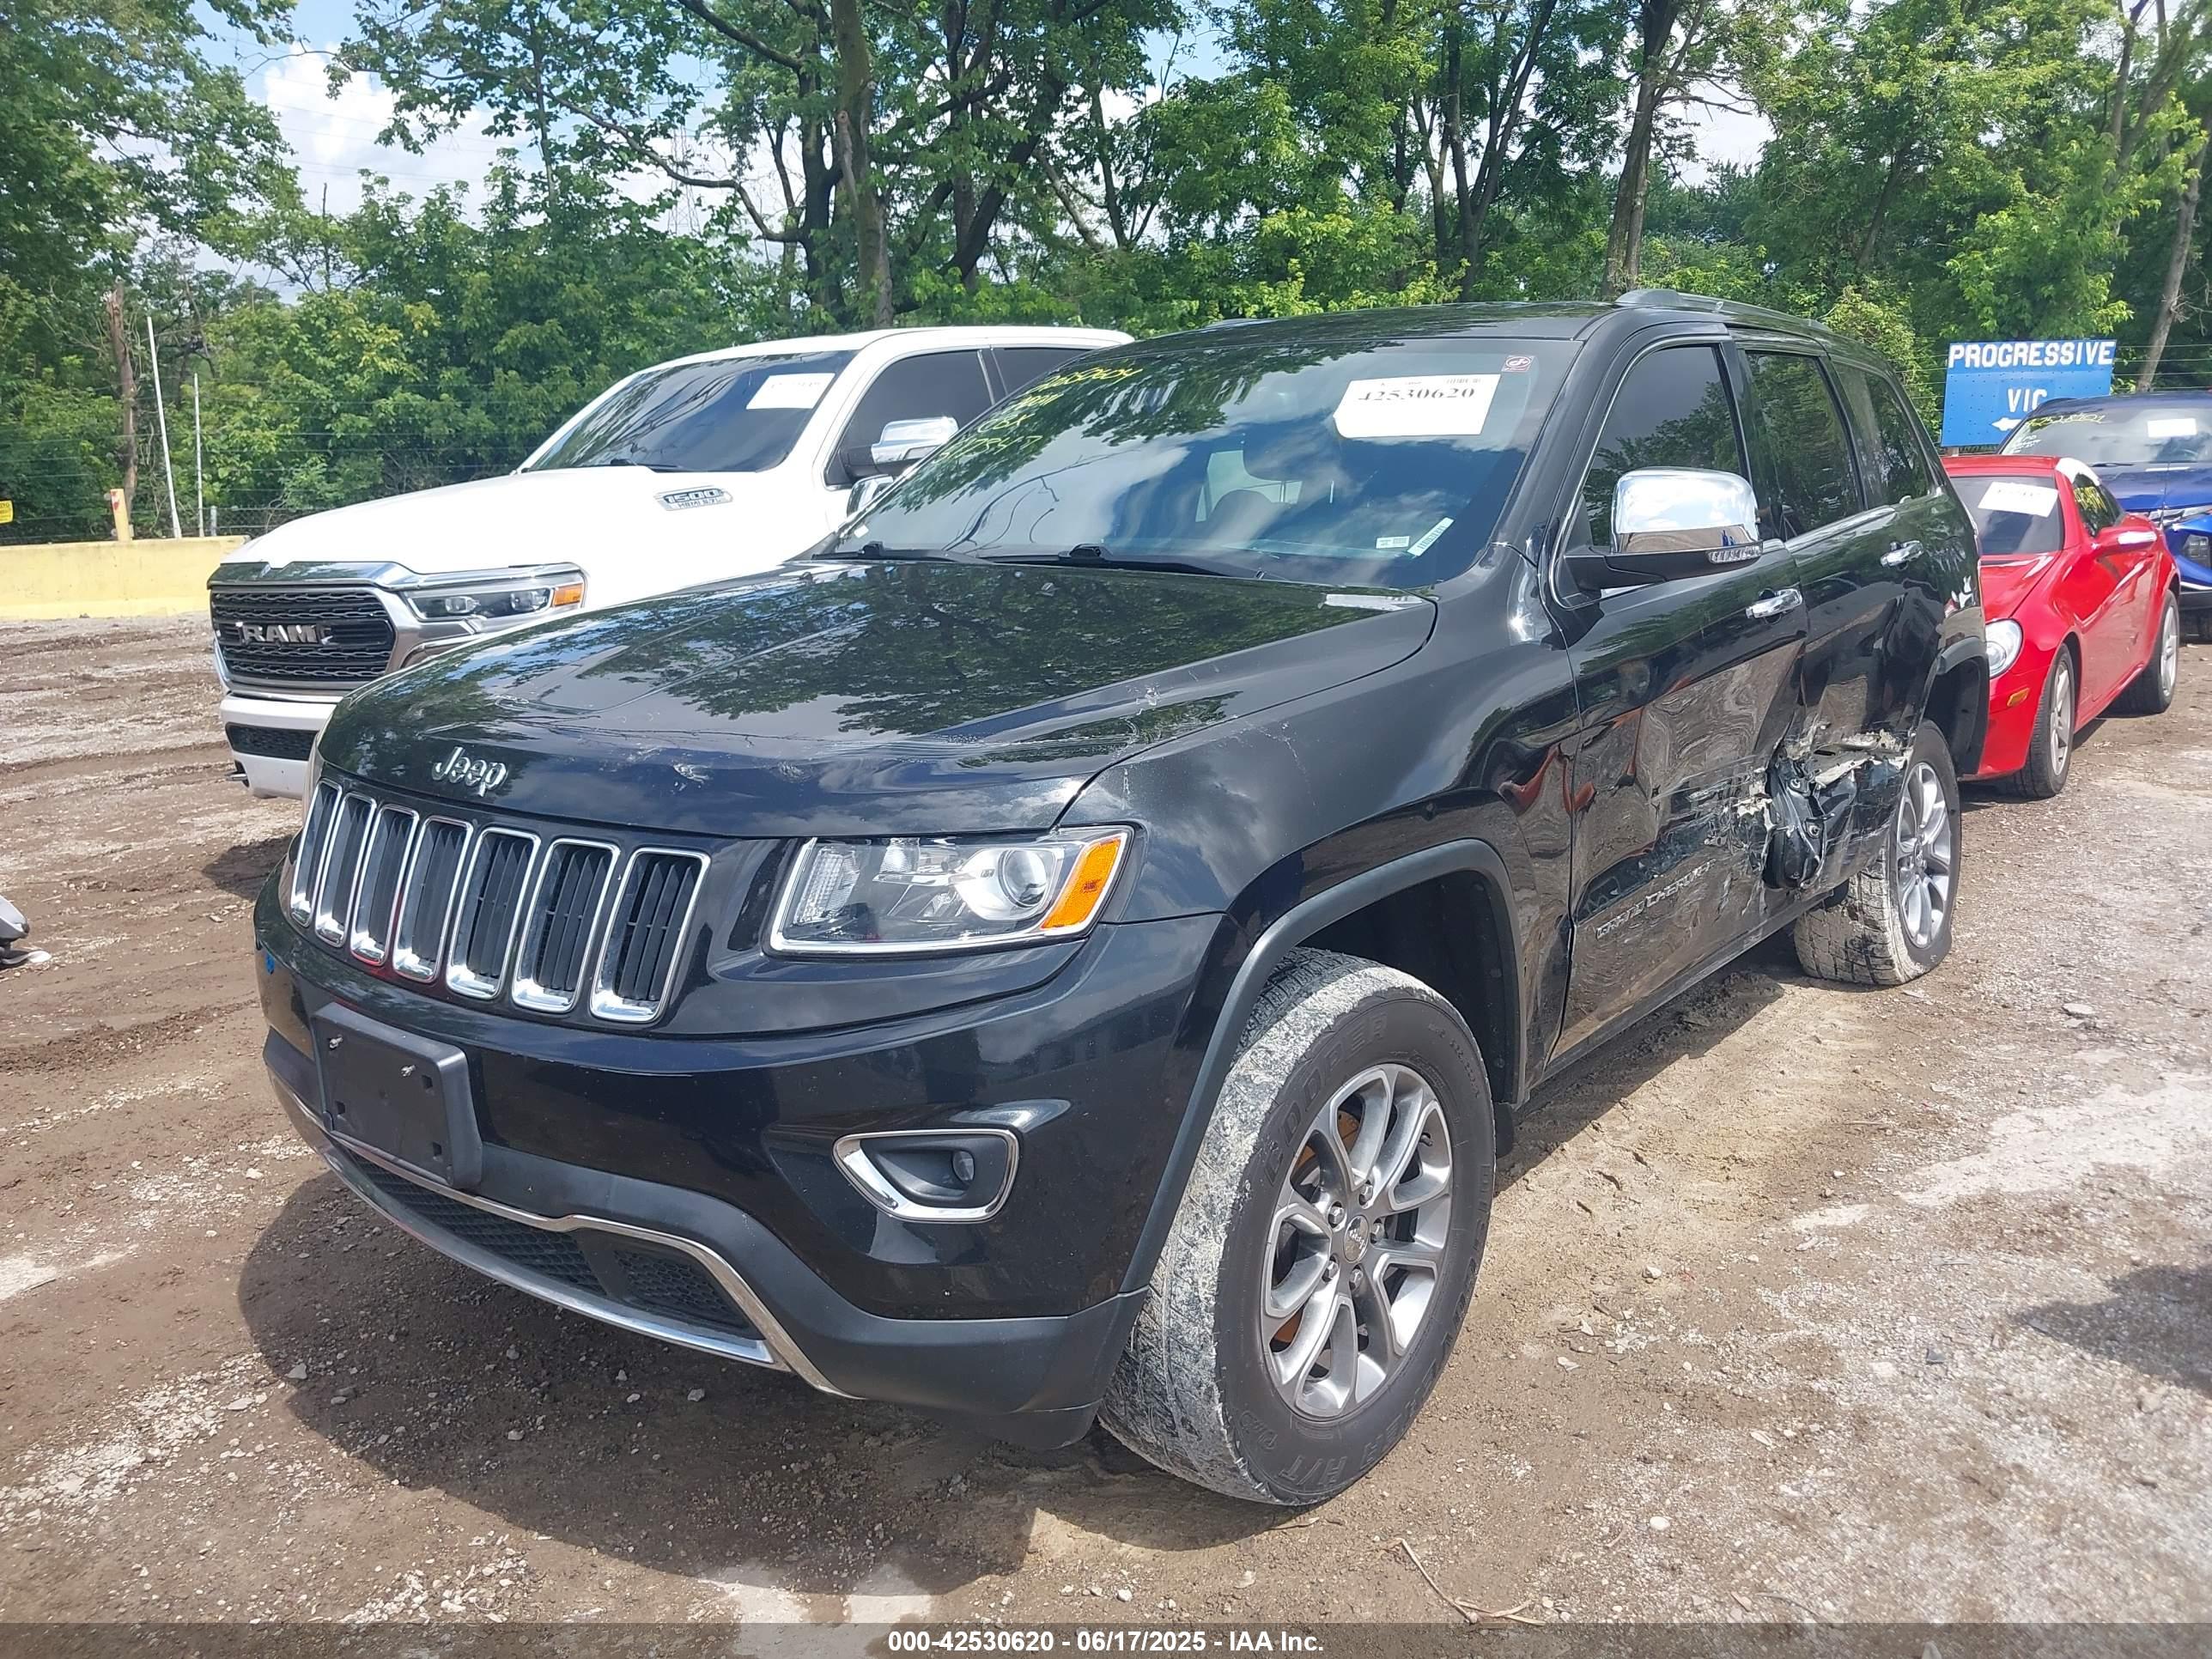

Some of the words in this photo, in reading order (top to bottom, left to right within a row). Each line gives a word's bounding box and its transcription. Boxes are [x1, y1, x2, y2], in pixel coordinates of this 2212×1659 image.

[1948, 341, 2116, 368] PROGRESSIVE
[1358, 387, 1475, 400] 42530620
[663, 488, 720, 503] 1500
[242, 624, 319, 643] RAM
[432, 746, 508, 797] Jeep
